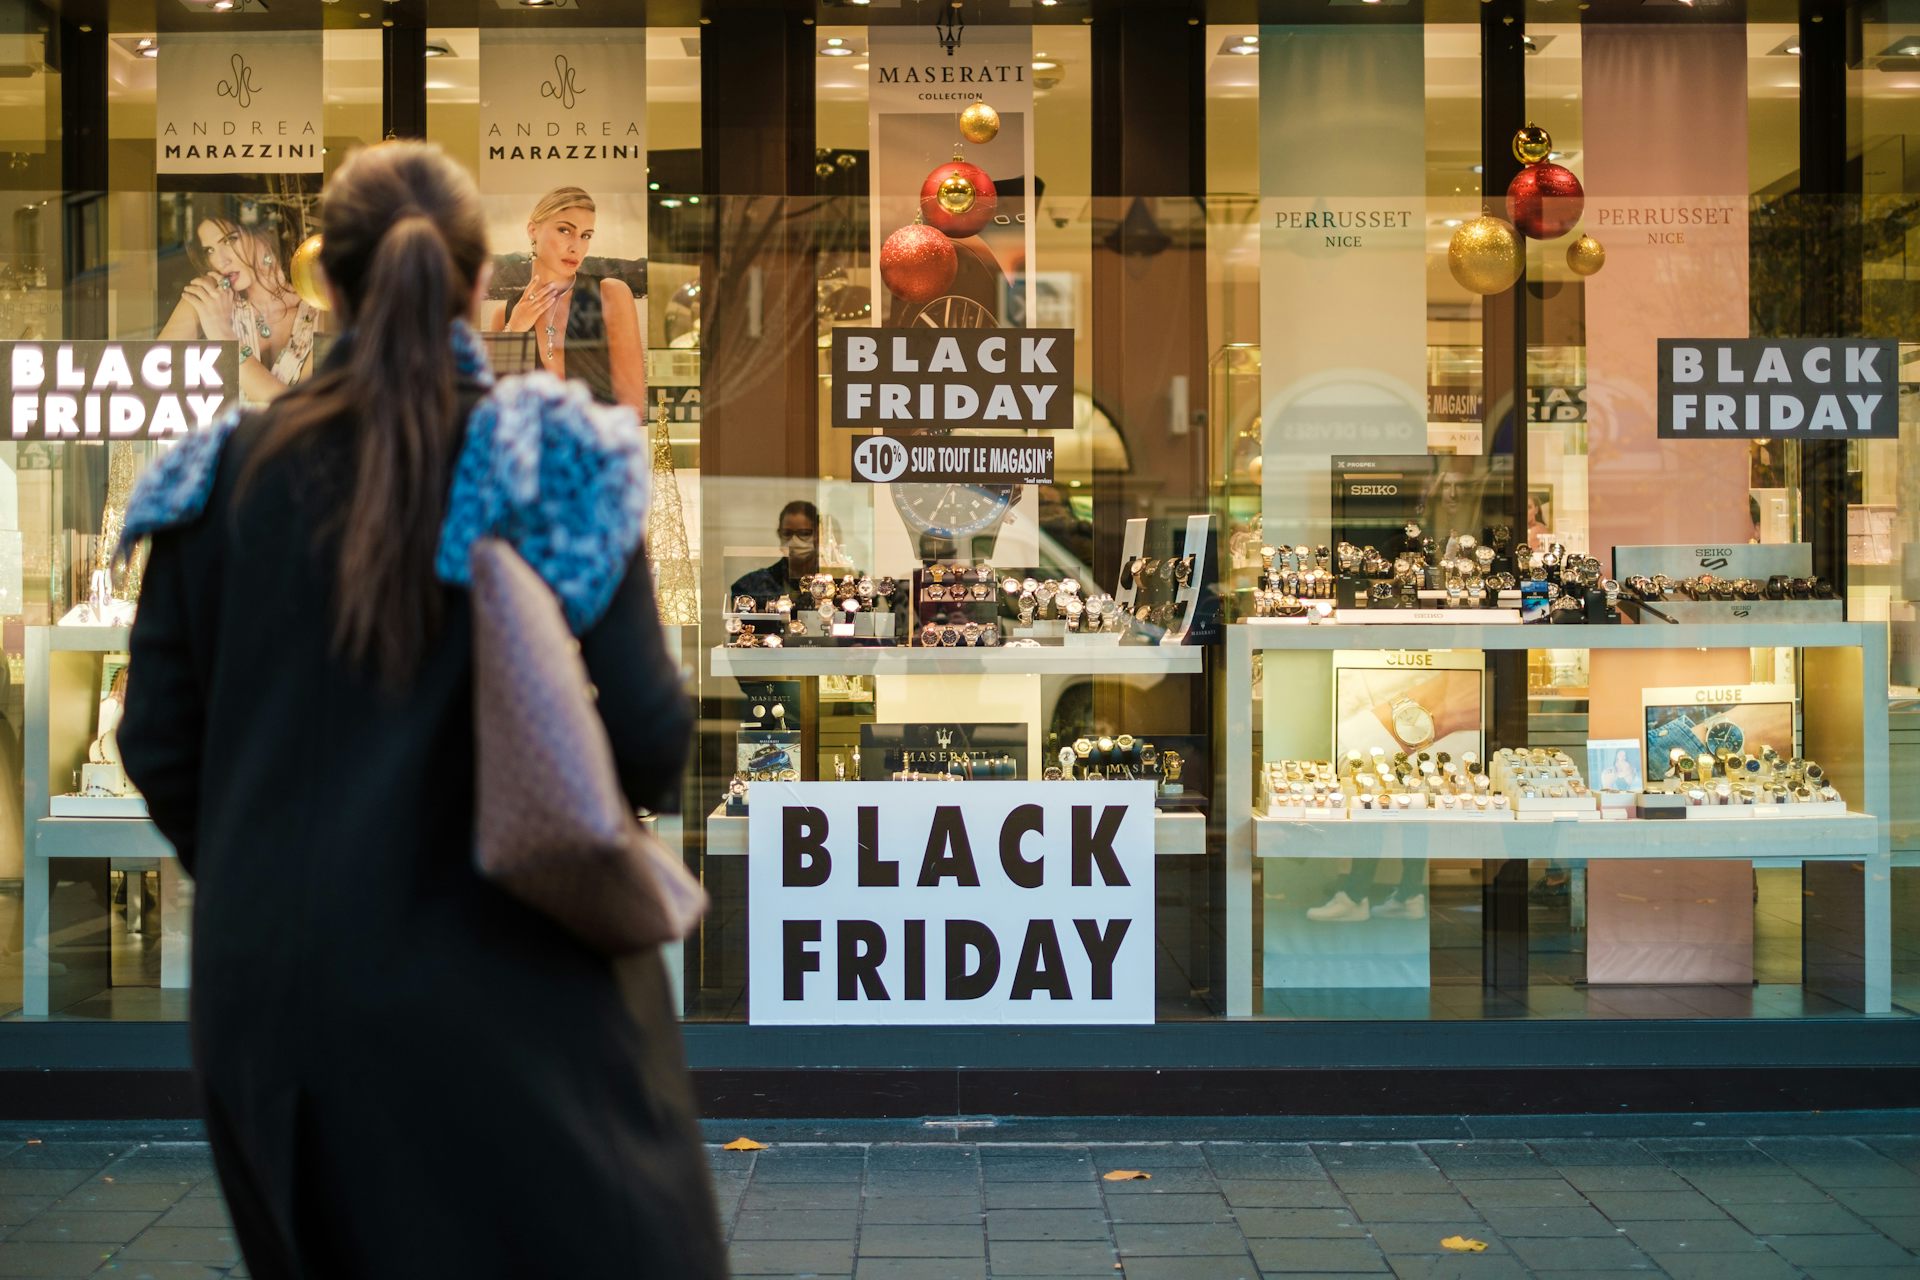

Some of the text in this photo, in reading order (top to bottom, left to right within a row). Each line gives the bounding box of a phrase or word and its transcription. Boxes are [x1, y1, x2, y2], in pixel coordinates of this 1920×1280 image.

[878, 65, 1025, 84] MASERATI
[918, 92, 983, 101] COLLECTION
[164, 120, 316, 136] ANDREA
[488, 122, 640, 137] ANDREA
[165, 144, 315, 159] MARAZZINI
[489, 145, 640, 160] MARAZZINI
[1275, 211, 1412, 228] PERRUSSET
[1597, 207, 1734, 226] PERRUSSET
[1325, 236, 1362, 248] NICE
[1647, 232, 1685, 244] NICE
[846, 336, 1059, 374] BLACK
[11, 343, 224, 391] BLACK
[1672, 346, 1882, 384] BLACK
[846, 383, 1059, 421] FRIDAY
[11, 392, 225, 439] FRIDAY
[1672, 394, 1883, 431] FRIDAY
[911, 446, 936, 473] SUR
[938, 447, 972, 474] TOUT
[973, 448, 987, 474] LE
[1350, 485, 1398, 495] SEIKO
[1695, 548, 1733, 557] SEIKO
[1386, 654, 1433, 666] CLUSE
[1695, 689, 1743, 702] CLUSE
[782, 803, 1131, 889] BLACK
[782, 918, 1132, 1001] FRIDAY
